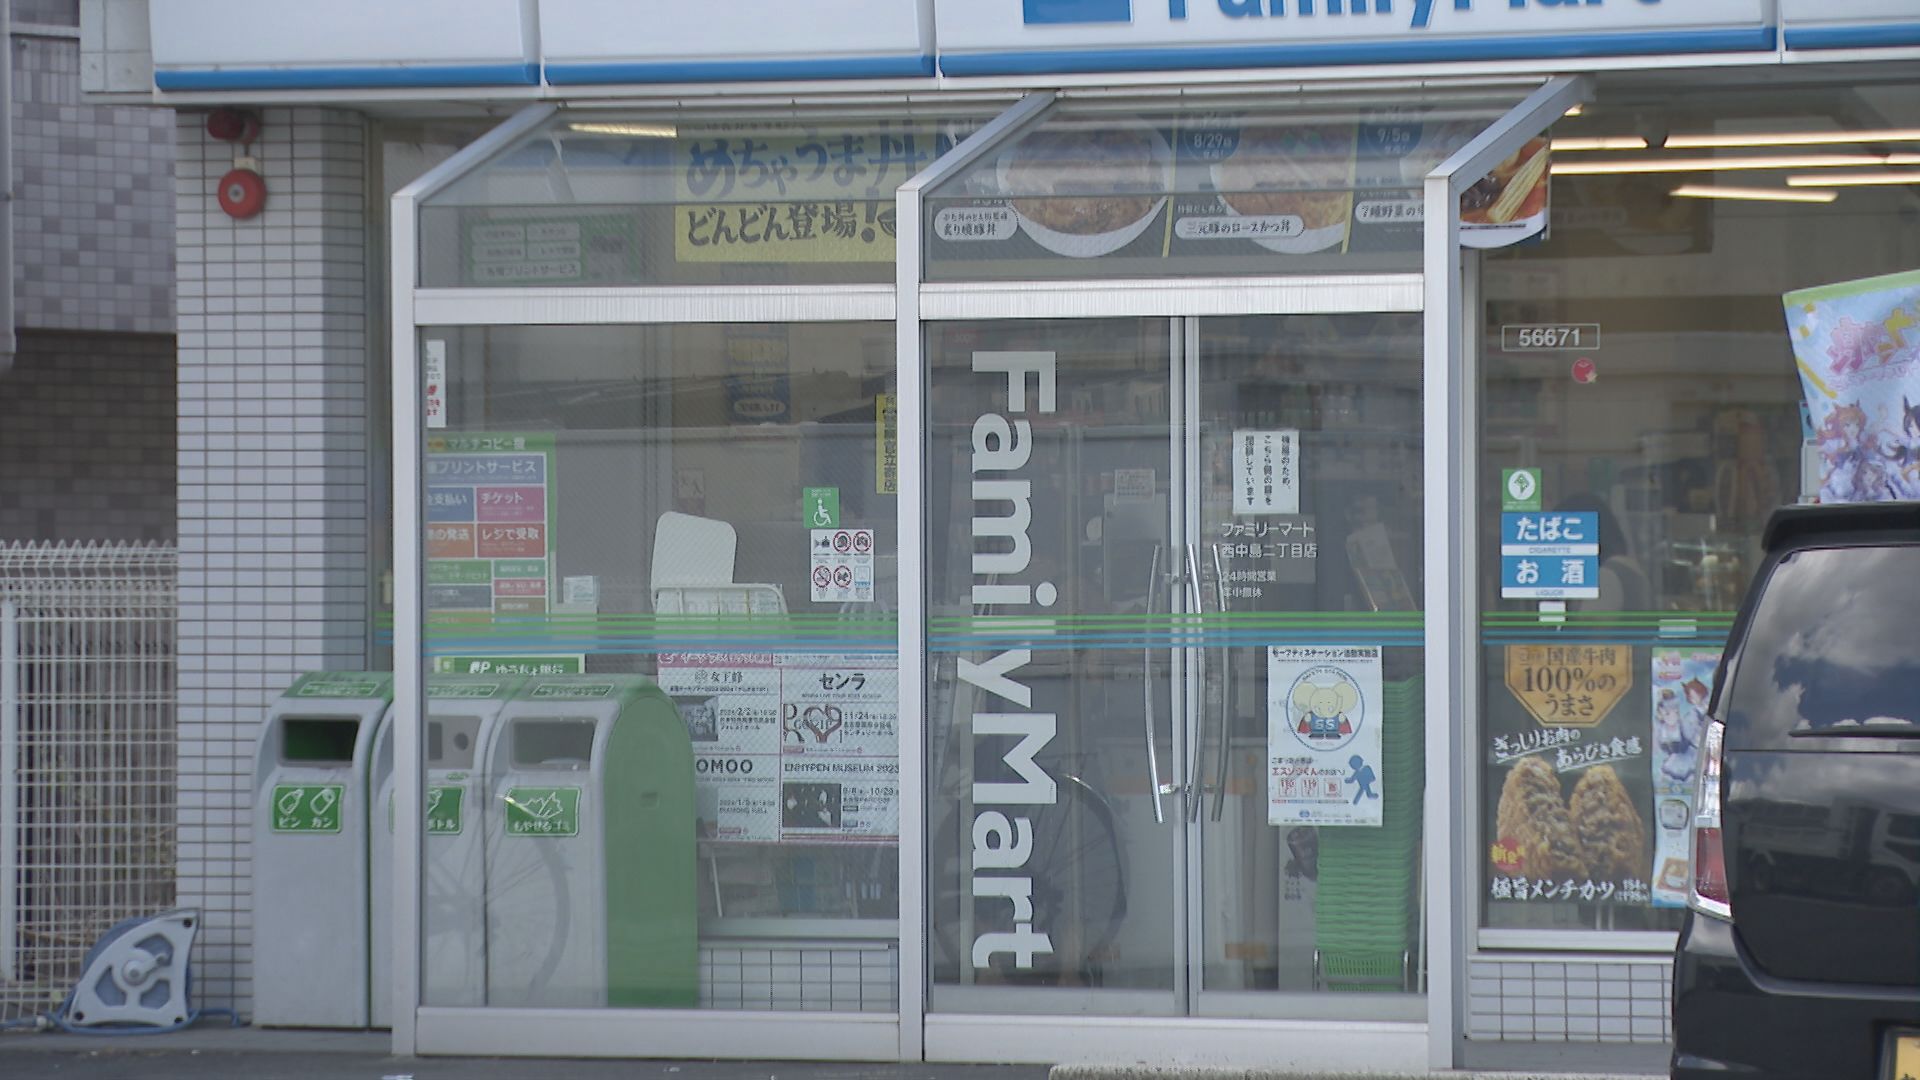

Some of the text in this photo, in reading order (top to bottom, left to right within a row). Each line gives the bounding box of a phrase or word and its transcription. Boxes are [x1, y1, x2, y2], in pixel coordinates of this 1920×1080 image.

[687, 186, 878, 248] どんどん登場!
[1518, 328, 1581, 347] 56671
[480, 492, 523, 504] チケット
[482, 527, 540, 541] レジで受取
[1221, 521, 1315, 538] ファミリーマート
[1516, 516, 1583, 541] たばこ
[1221, 543, 1318, 559] 西中島二丁目店
[1528, 546, 1571, 554] CIGARETTE
[1516, 560, 1585, 585] お酒
[1535, 588, 1564, 596] LIQUOR
[957, 351, 1058, 969] FamilyMart
[818, 672, 867, 691] センラ
[1523, 666, 1617, 693] 100%の
[1545, 693, 1595, 717] うまさ
[1556, 736, 1643, 769] あらびき食感
[278, 816, 334, 829] ビン カン
[1491, 876, 1616, 901] 極旨メンチカツ
